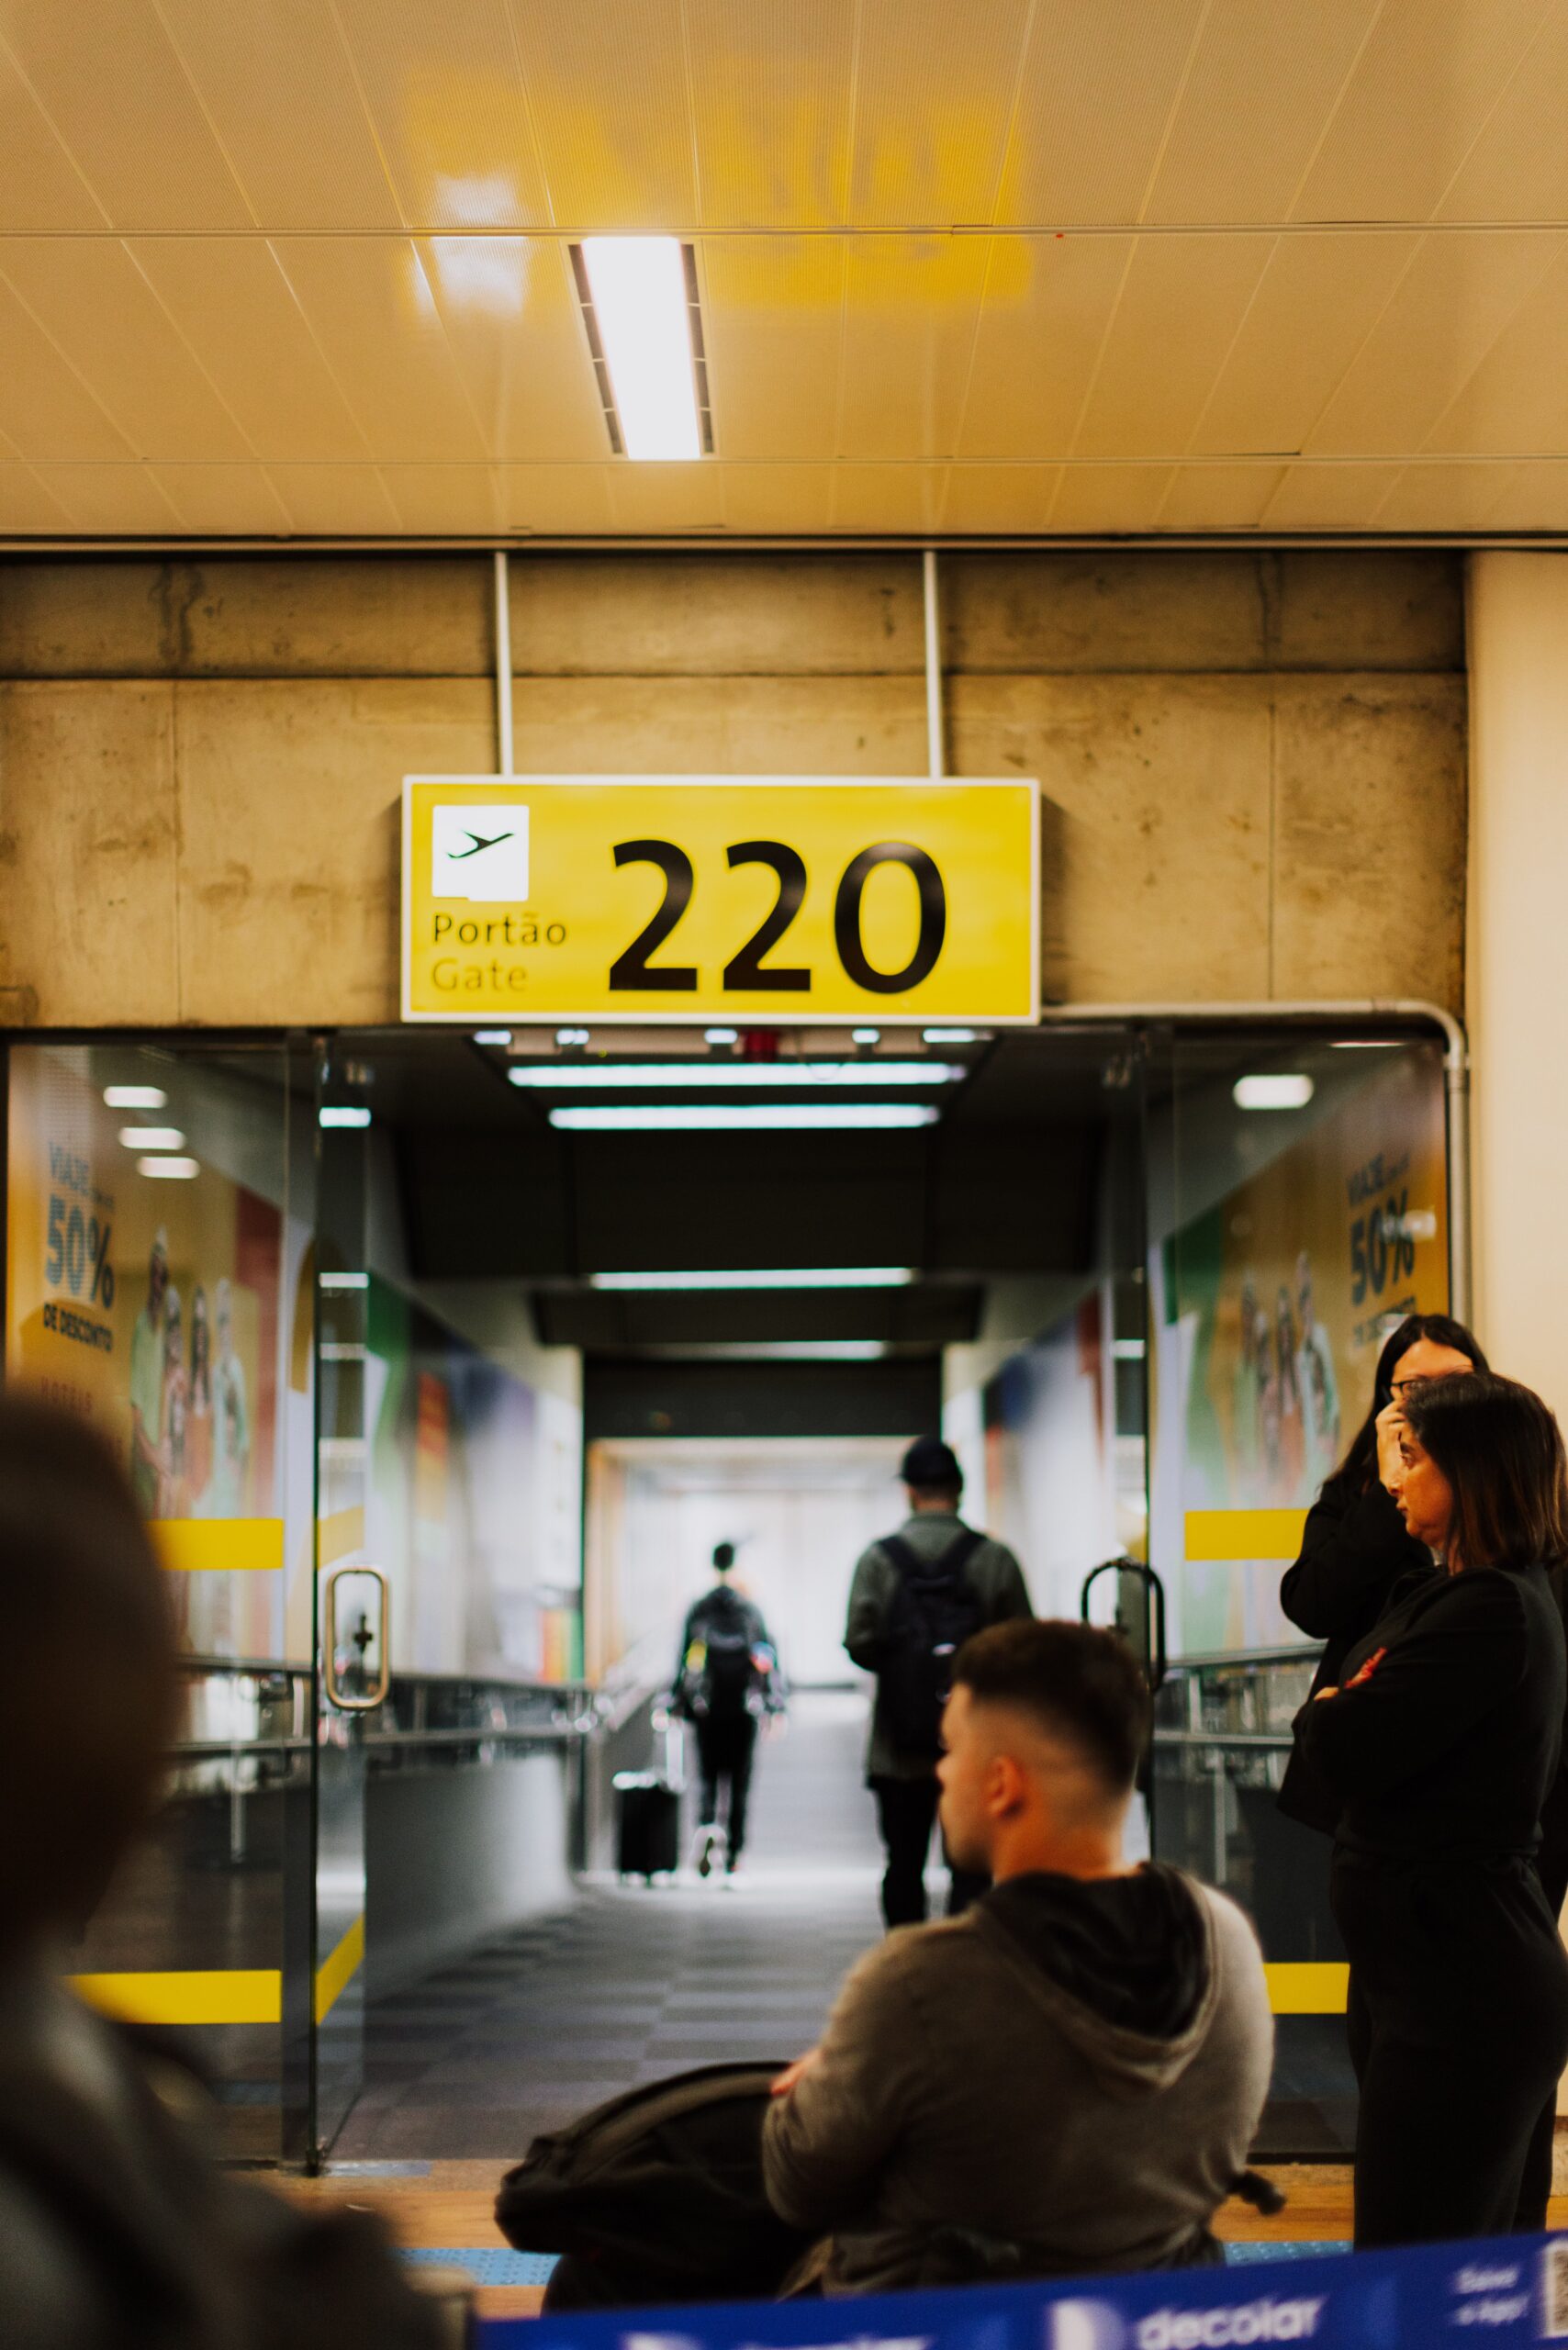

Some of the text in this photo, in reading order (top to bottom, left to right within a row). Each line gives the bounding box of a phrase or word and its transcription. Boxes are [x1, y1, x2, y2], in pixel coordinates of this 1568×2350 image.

[433, 911, 567, 946] Portão
[610, 839, 946, 994] 220
[431, 958, 528, 992] Gate
[46, 1193, 115, 1309] 50%
[1350, 1188, 1415, 1307] 50%
[1138, 2296, 1327, 2350] decolar
